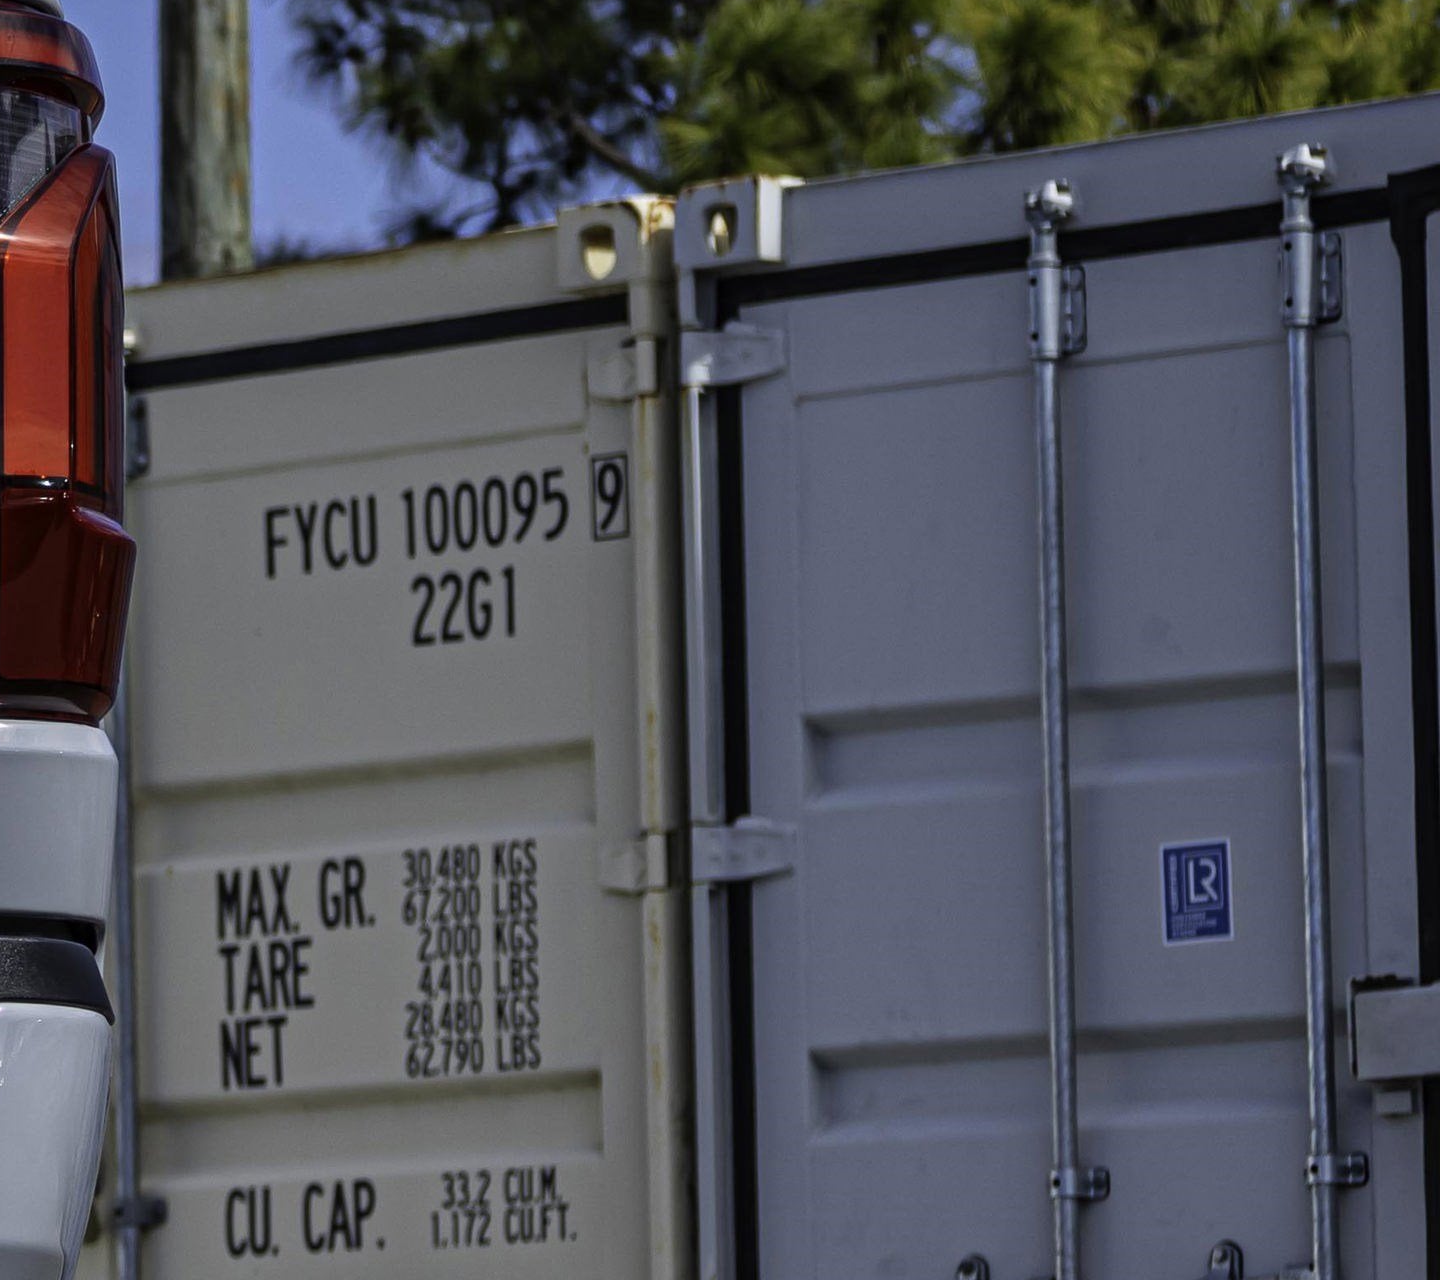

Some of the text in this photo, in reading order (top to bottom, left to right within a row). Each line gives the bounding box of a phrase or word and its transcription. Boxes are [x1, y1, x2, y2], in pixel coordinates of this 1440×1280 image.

[265, 461, 624, 579] FYCU 100095 9
[411, 565, 517, 647] 22G1
[216, 863, 301, 940] MAX.
[319, 855, 376, 930] GR.
[492, 838, 538, 879] KGS
[493, 879, 538, 917] LBS
[219, 935, 315, 1014] TARE
[493, 917, 539, 954] KGS
[494, 957, 540, 994] LBS
[220, 1015, 288, 1089] NET
[495, 995, 541, 1033] KGS
[496, 1034, 542, 1073] LBS
[225, 1185, 280, 1258] CU.
[302, 1177, 386, 1253] CAP.
